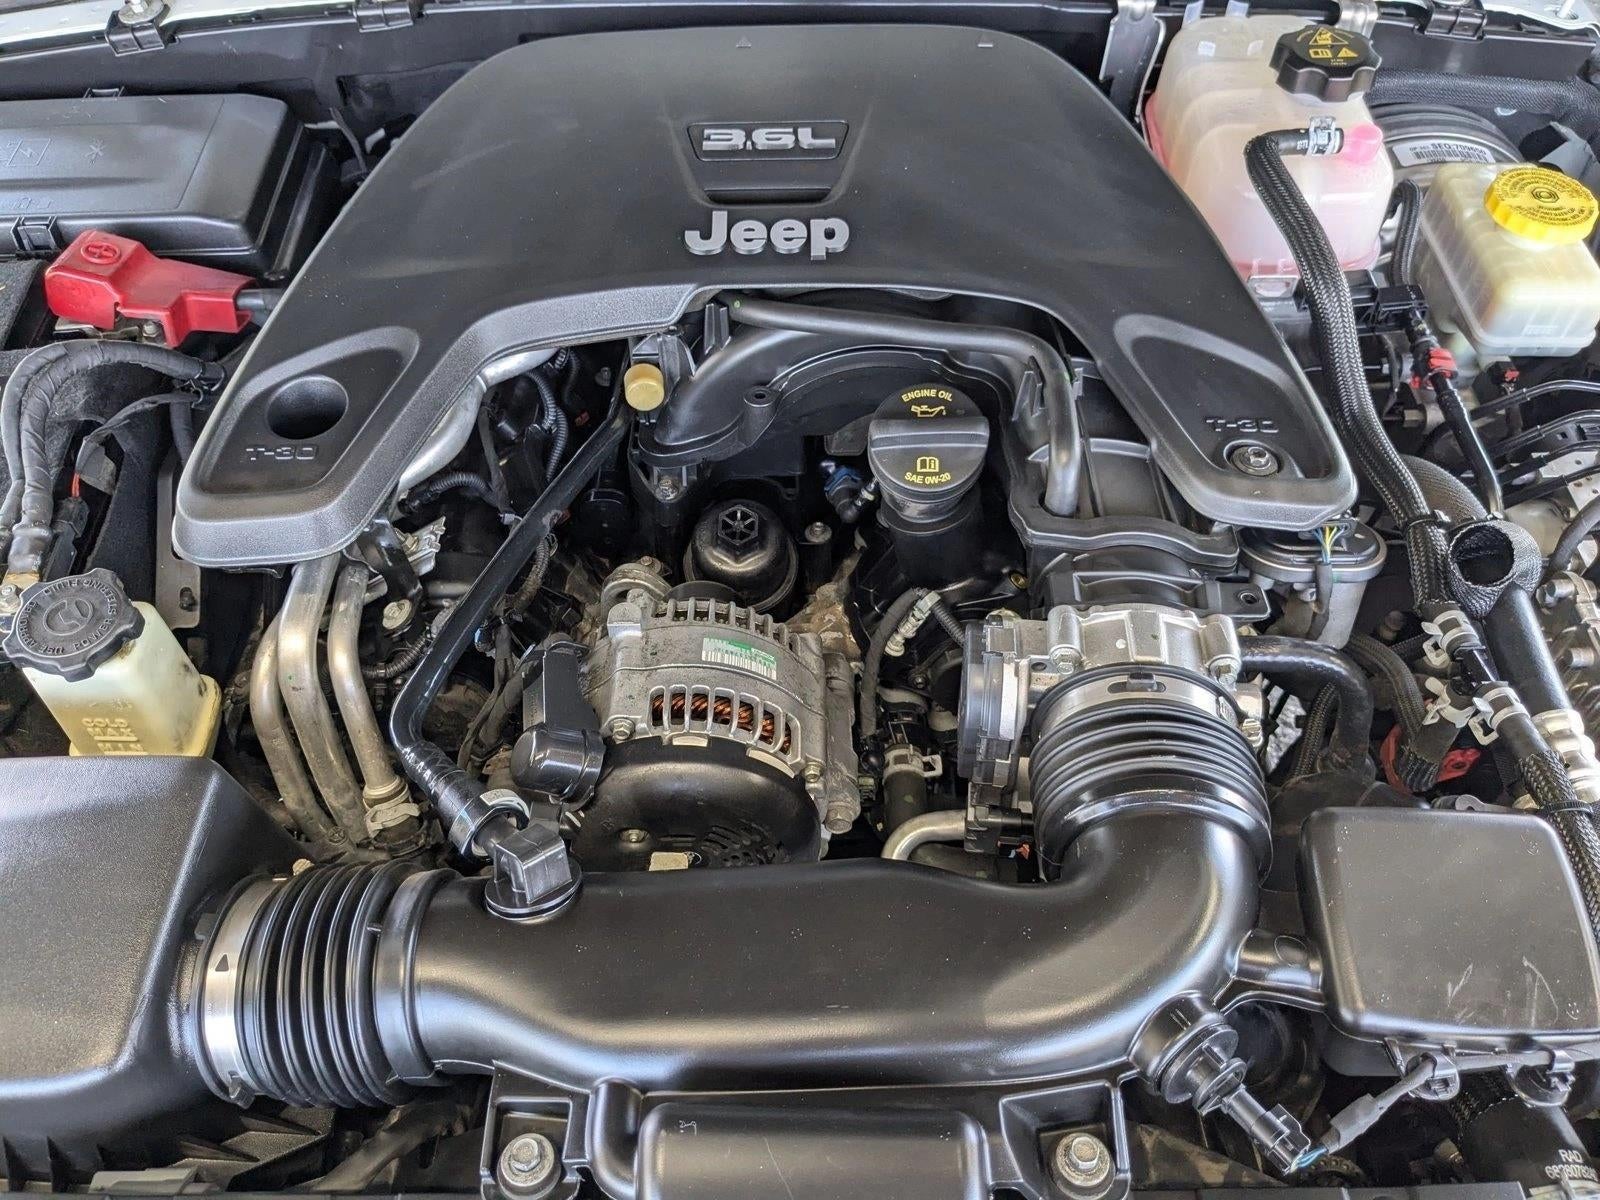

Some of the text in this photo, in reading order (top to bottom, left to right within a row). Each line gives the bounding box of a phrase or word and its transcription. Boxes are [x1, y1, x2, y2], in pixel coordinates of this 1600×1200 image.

[702, 127, 836, 151] 3.6L
[684, 210, 850, 261] Jeep
[901, 389, 953, 402] ENGINE OIL
[1205, 417, 1279, 433] T-30
[244, 445, 317, 461] T-30
[904, 472, 952, 485] SAE 0W-20
[42, 578, 117, 651] POWER STEERING FLUID
[82, 718, 128, 728] COLD
[86, 727, 135, 737] MAX
[97, 743, 144, 753] MIN
[1558, 1149, 1584, 1164] RAD
